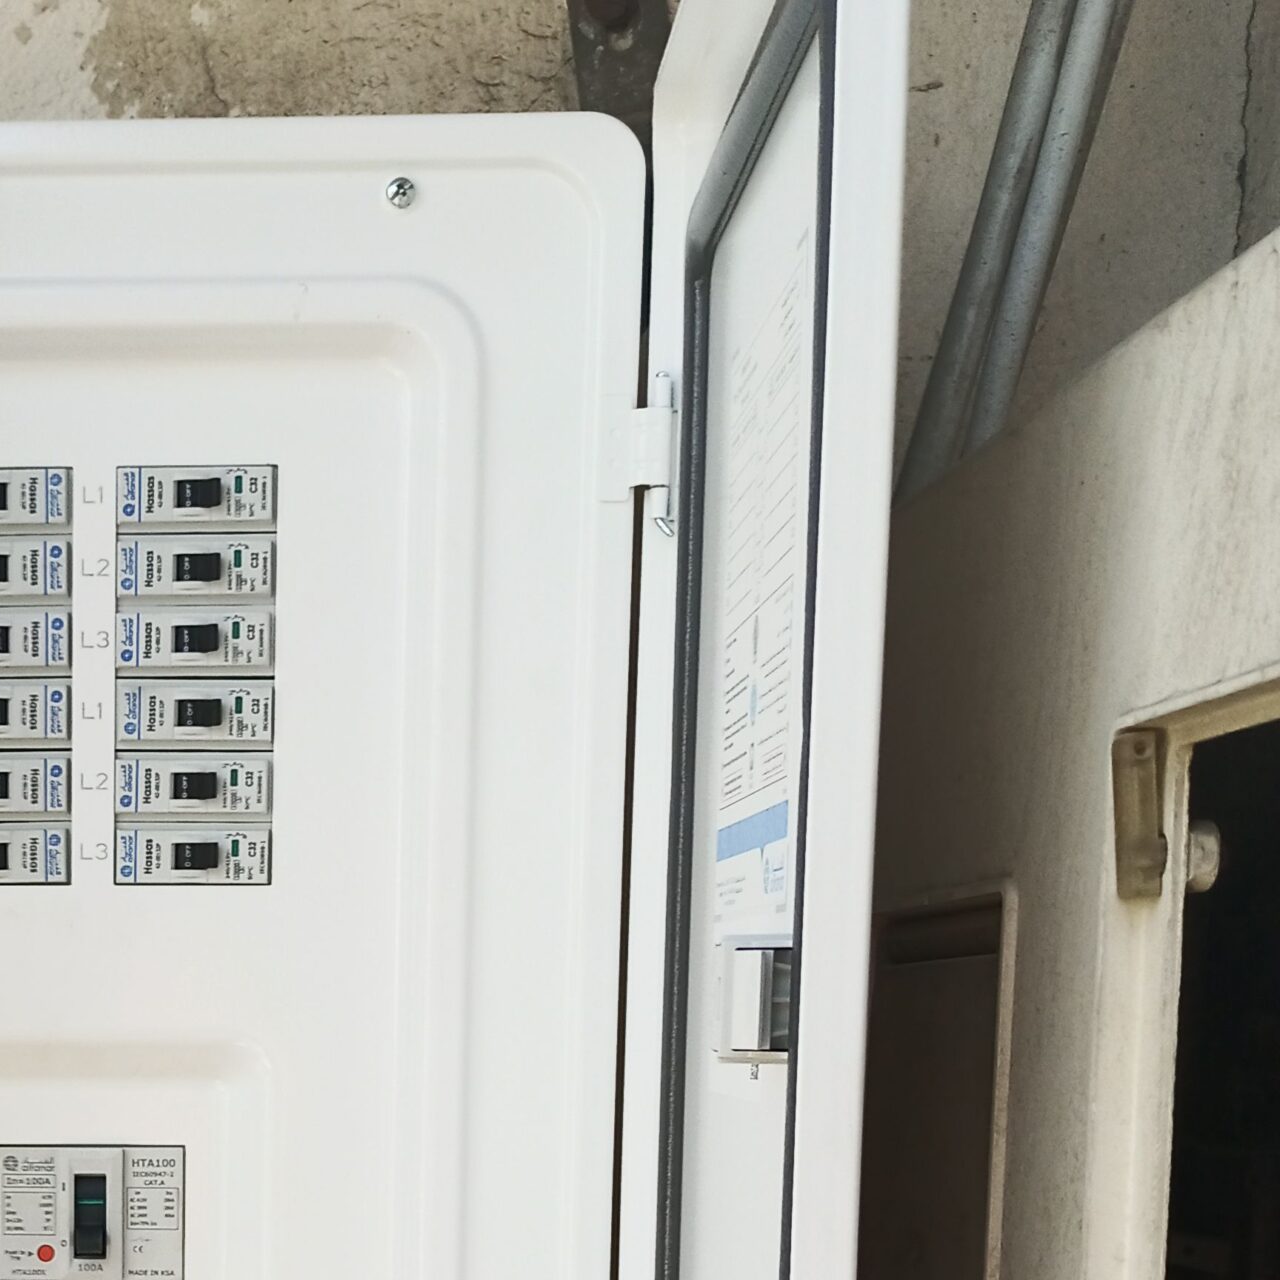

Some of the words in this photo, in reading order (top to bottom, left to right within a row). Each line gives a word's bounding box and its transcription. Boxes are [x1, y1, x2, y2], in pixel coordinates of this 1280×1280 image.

[249, 477, 258, 493] C32
[29, 478, 38, 514] Hassas
[82, 486, 104, 504] L1
[145, 476, 154, 513] Hassas
[30, 550, 39, 586] Hassas
[82, 559, 110, 576] L2
[250, 552, 259, 568] C32
[145, 551, 153, 587] Hassas
[31, 622, 40, 657] Hassas
[82, 631, 110, 648] L3
[143, 622, 152, 659] Hassas
[247, 624, 255, 640] C32
[30, 695, 39, 730] Hassas
[82, 702, 103, 719] L1
[147, 696, 156, 732] Hassas
[251, 699, 260, 714] C32
[31, 769, 40, 804] Hassas
[81, 773, 109, 790] L2
[143, 768, 152, 804] Hassas
[245, 771, 254, 787] C32
[30, 838, 39, 873] Hassas
[80, 843, 109, 860] L3
[144, 839, 153, 874] Hassas
[248, 842, 257, 857] C32
[132, 1159, 176, 1167] HTA100
[78, 1264, 103, 1272] 100A
